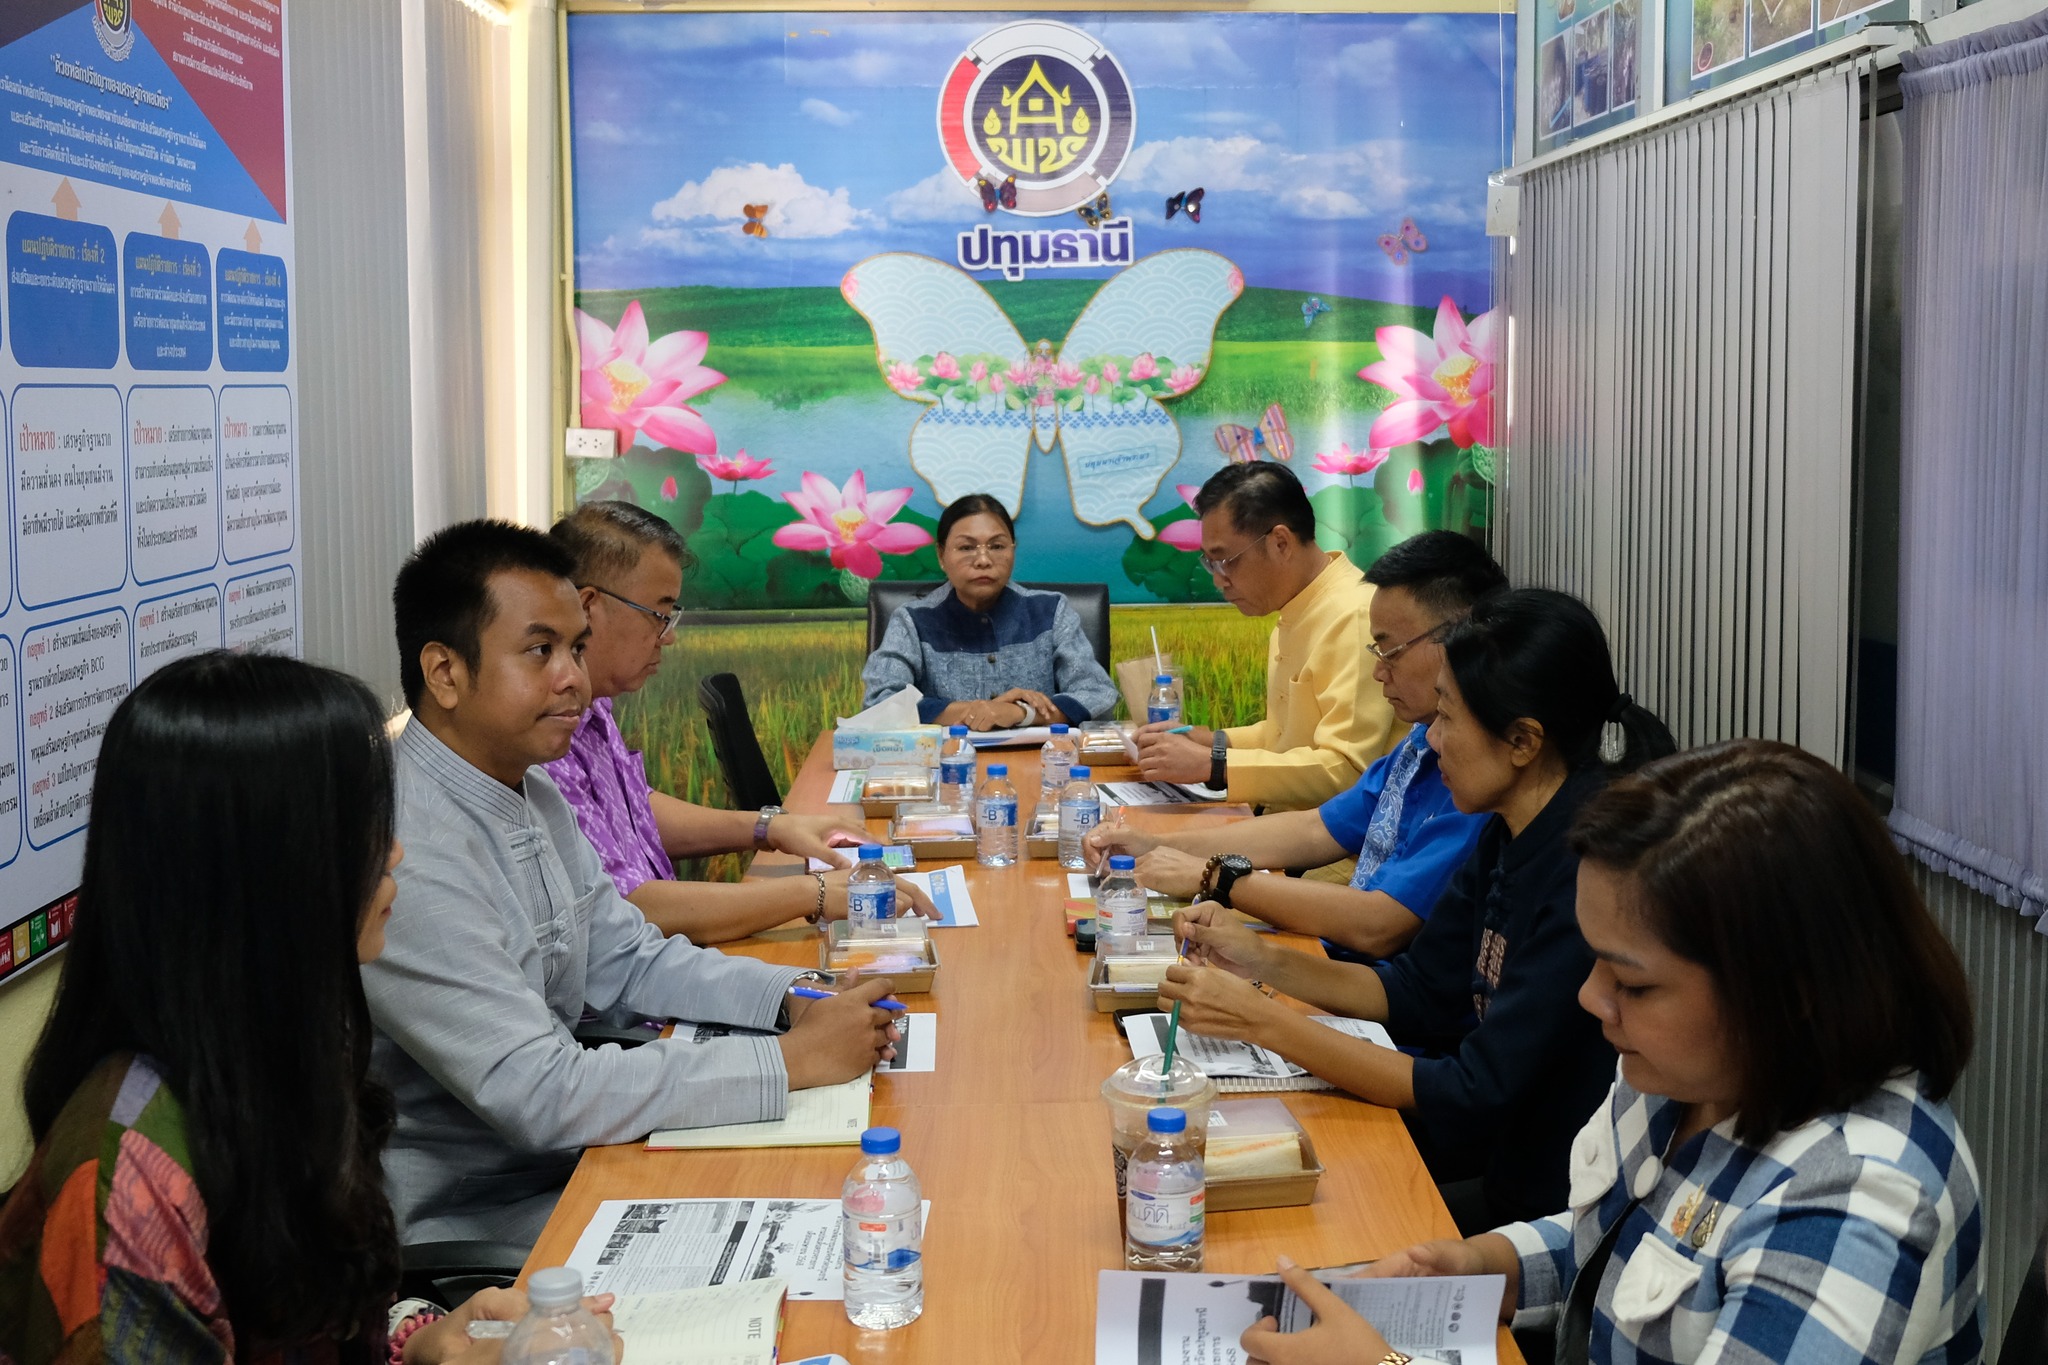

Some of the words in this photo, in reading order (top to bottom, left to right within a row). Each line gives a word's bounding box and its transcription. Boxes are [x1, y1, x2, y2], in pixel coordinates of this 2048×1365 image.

[960, 218, 1131, 279] ปทุมธานี
[19, 423, 56, 452] เป้าหมาย
[21, 464, 62, 491] มีความมั่นคง
[91, 656, 105, 673] BCG
[747, 1316, 762, 1340] NOTE
